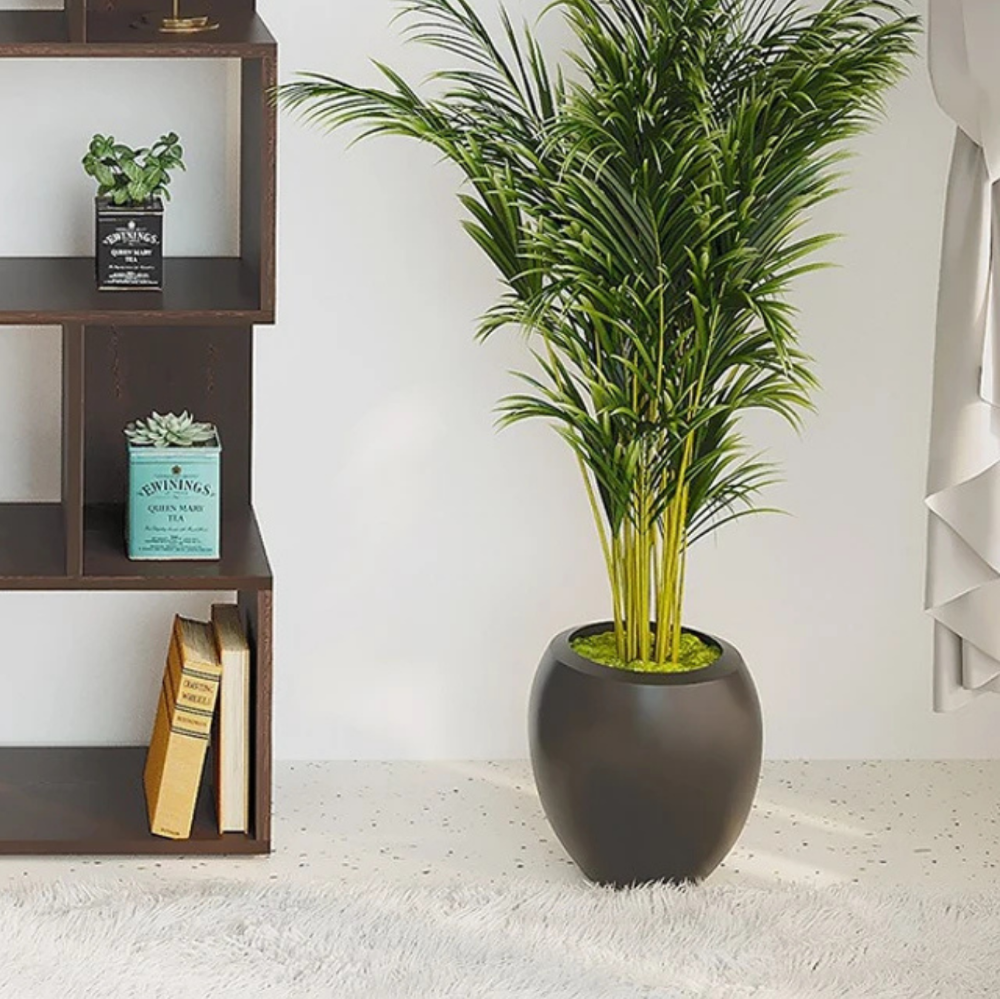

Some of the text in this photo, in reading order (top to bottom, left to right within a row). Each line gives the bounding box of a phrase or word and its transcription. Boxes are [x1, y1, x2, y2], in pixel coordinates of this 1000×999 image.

[147, 504, 204, 514] QUEEN MARY
[167, 514, 185, 523] TEA
